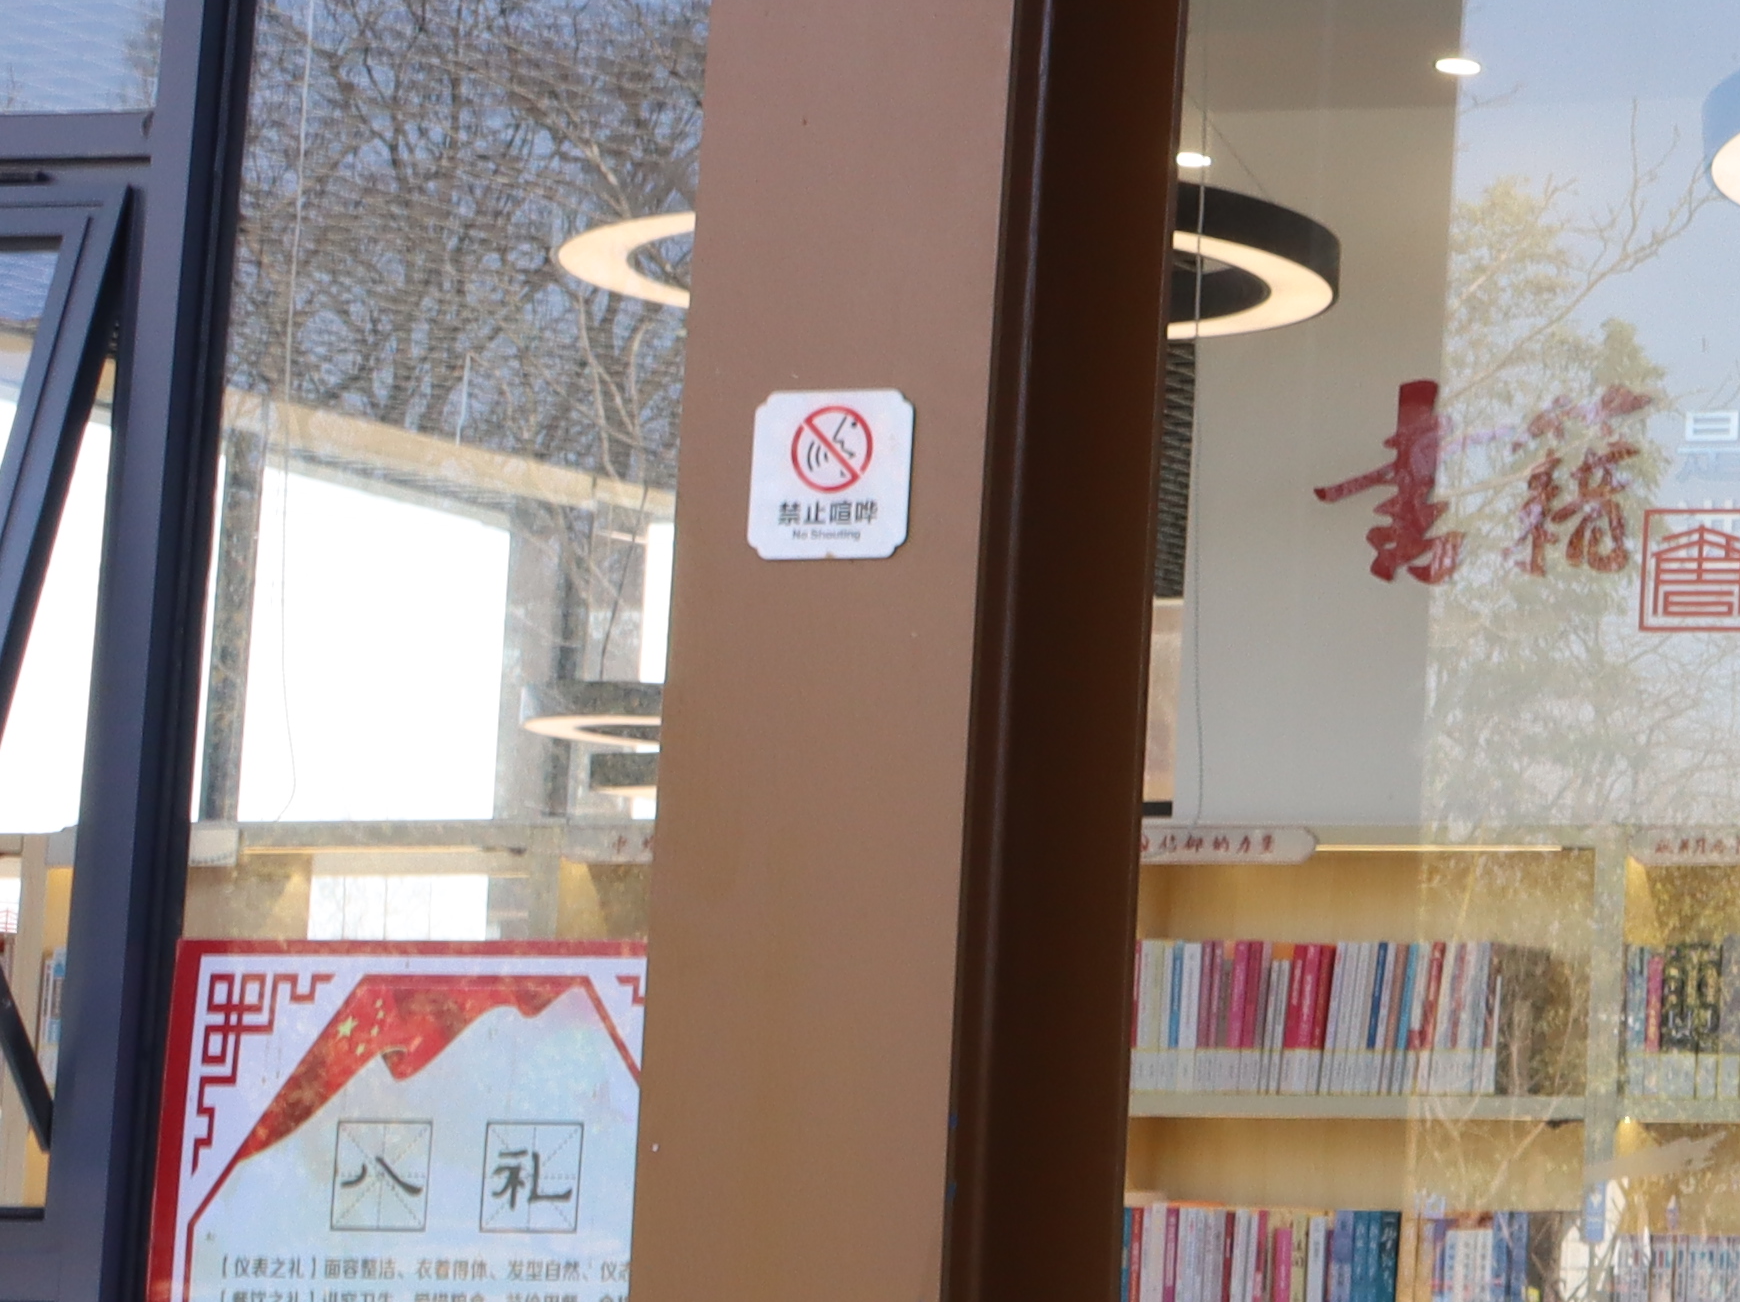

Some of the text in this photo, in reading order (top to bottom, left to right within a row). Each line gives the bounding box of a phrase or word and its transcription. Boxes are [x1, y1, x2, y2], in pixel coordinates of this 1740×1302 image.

[778, 500, 878, 526] 禁止喧哗
[792, 529, 861, 541] No Shouting
